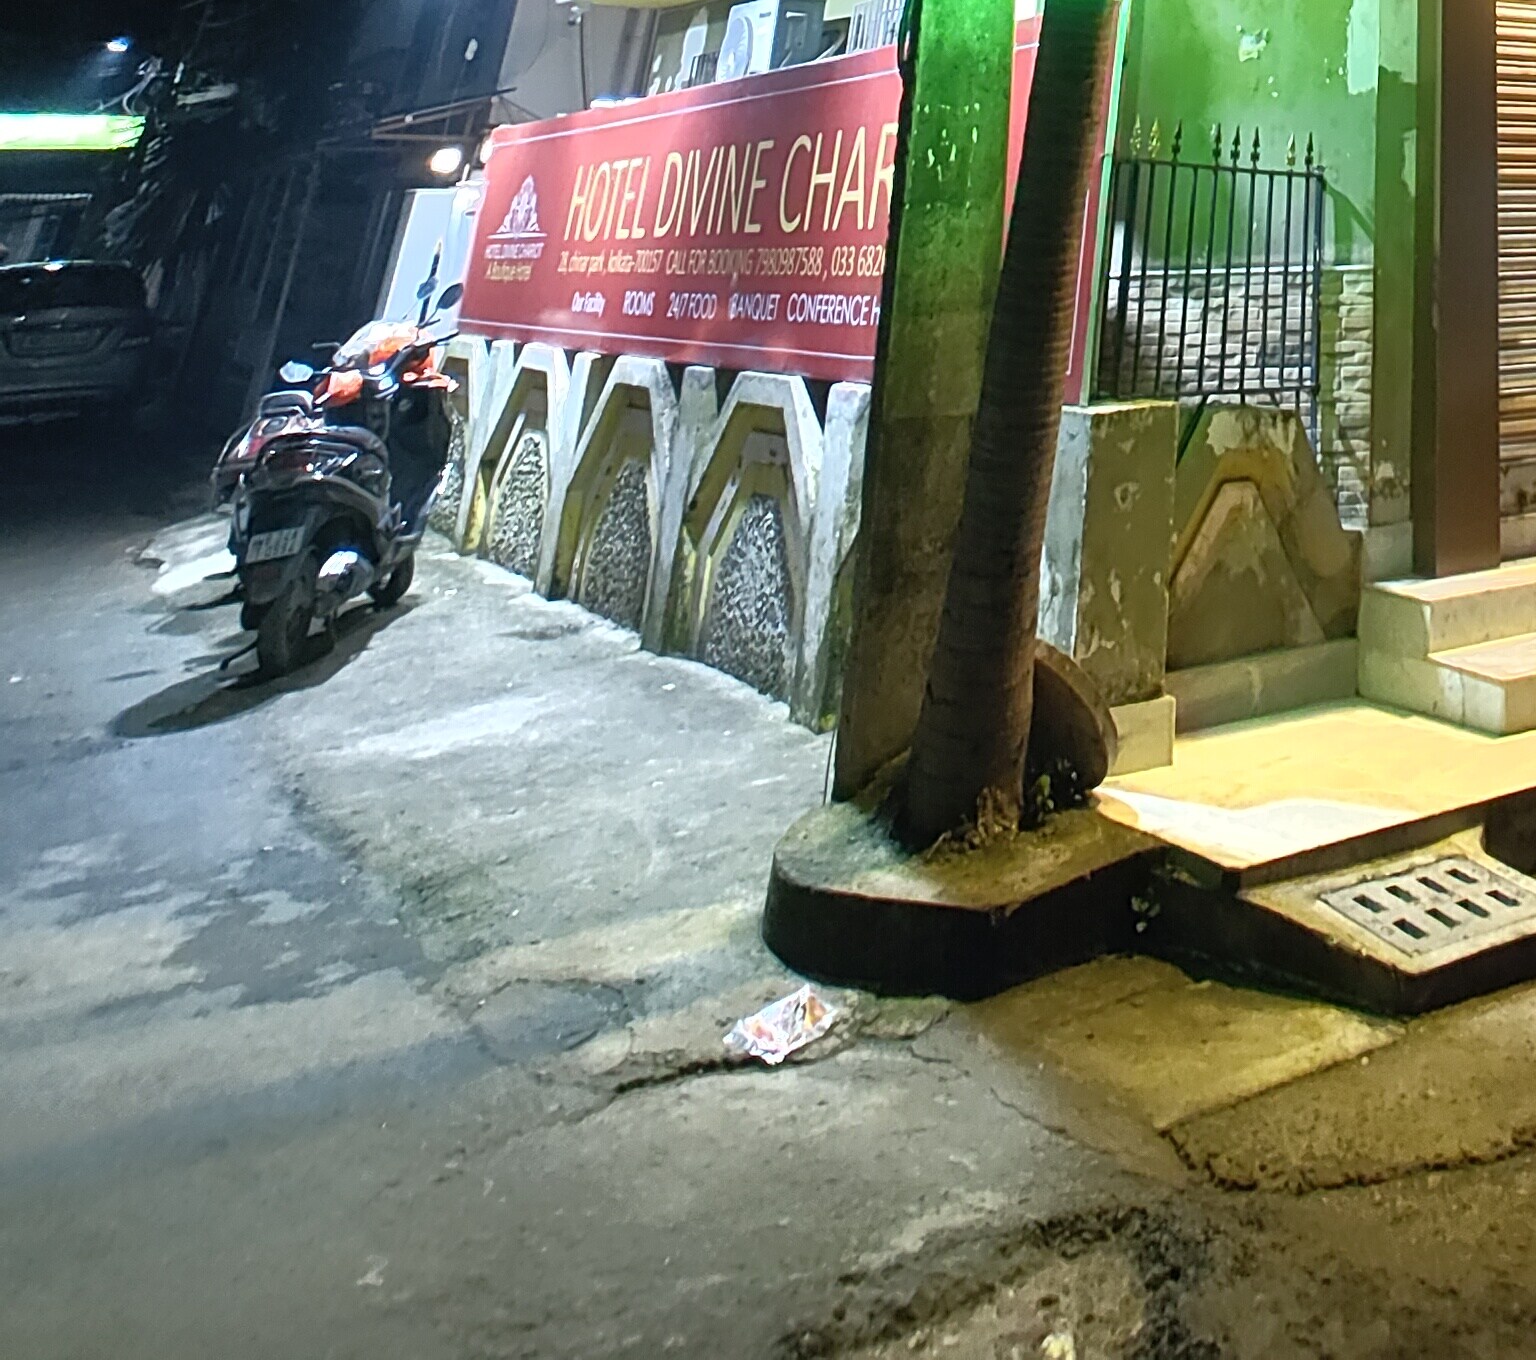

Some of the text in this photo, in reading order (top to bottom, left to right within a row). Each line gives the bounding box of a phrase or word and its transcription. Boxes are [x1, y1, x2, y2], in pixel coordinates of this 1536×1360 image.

[563, 156, 651, 242] HOTEL
[653, 140, 774, 238] DIVINE
[665, 249, 687, 275] CALL
[687, 248, 707, 275] FOR
[708, 247, 754, 276] BOOKING
[831, 244, 855, 276] 033
[622, 290, 656, 316] ROOMS
[687, 292, 718, 319] FOOD
[731, 293, 781, 321] BANQUET
[787, 293, 869, 326] CONFERENCE
